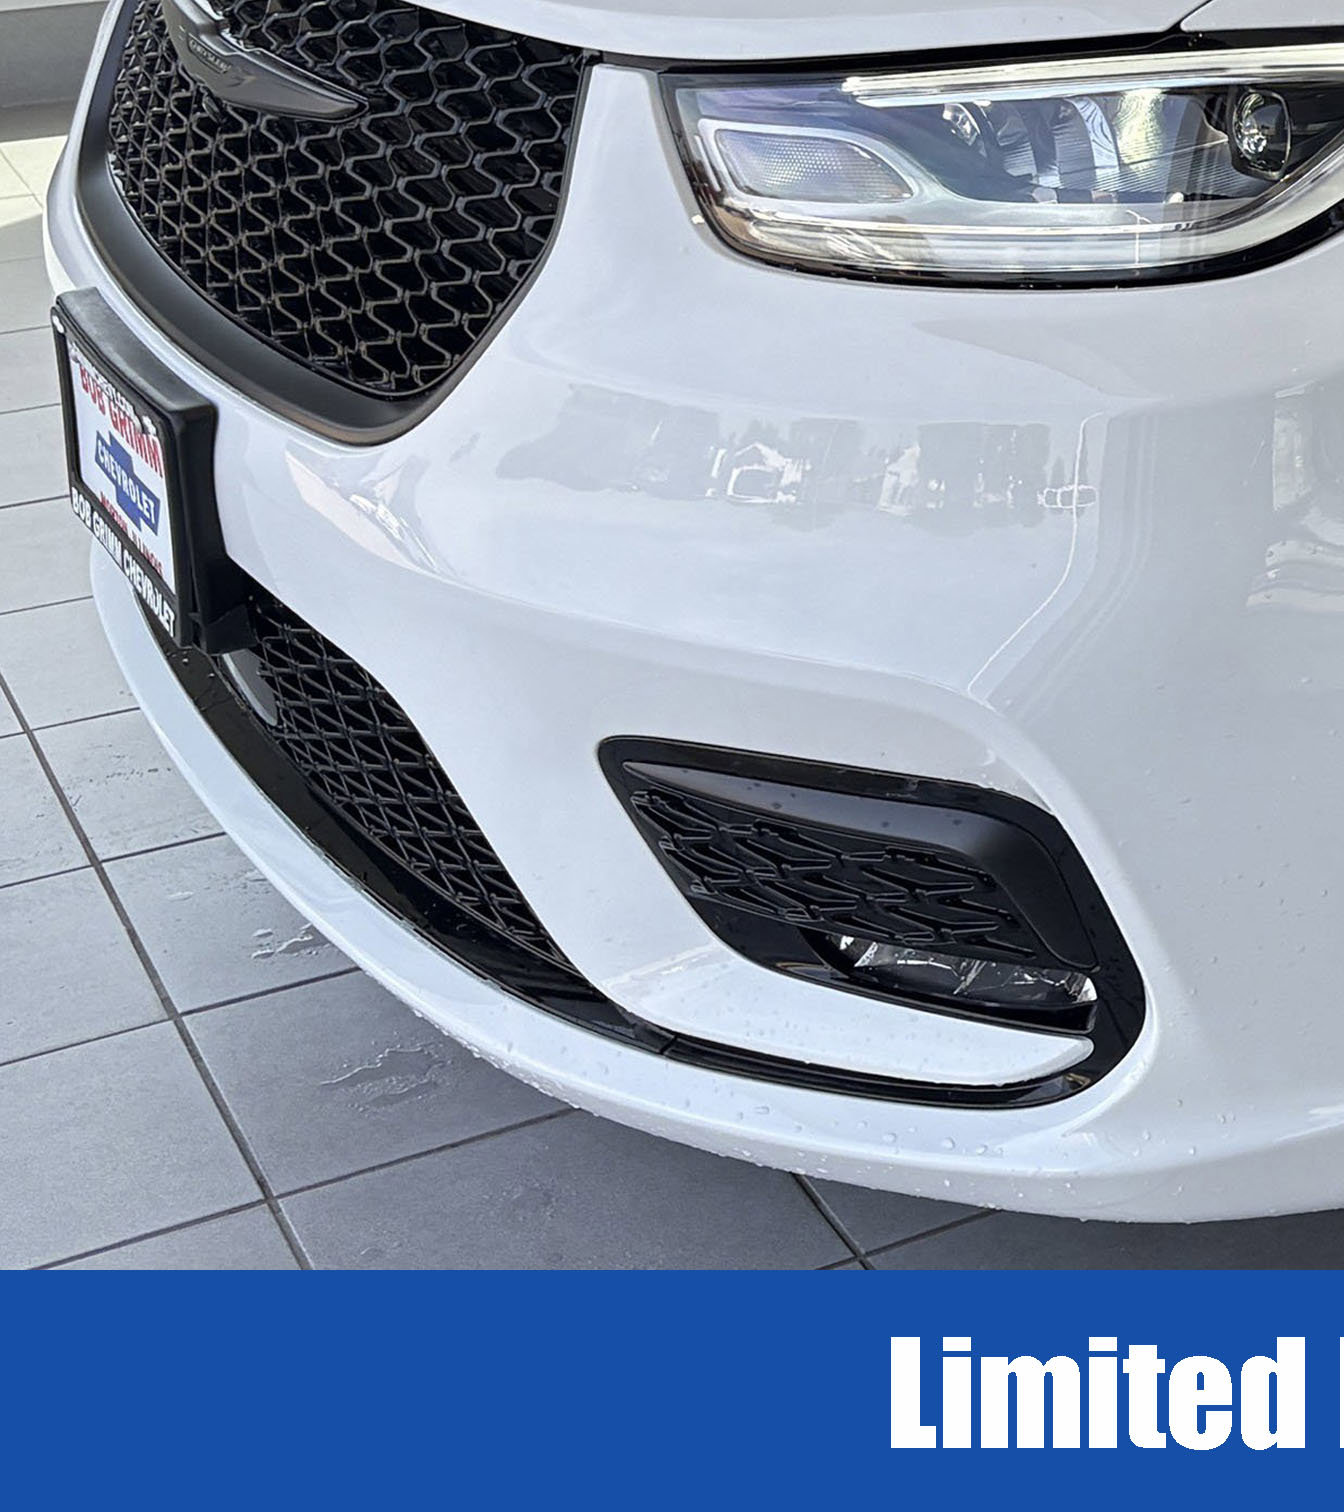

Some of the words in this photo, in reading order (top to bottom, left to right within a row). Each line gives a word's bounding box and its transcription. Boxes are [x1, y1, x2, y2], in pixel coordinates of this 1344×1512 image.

[97, 439, 155, 525] CHEVROLET
[72, 487, 93, 529] BOB
[93, 511, 123, 569] GRIMM
[123, 549, 176, 638] CHEVROLET
